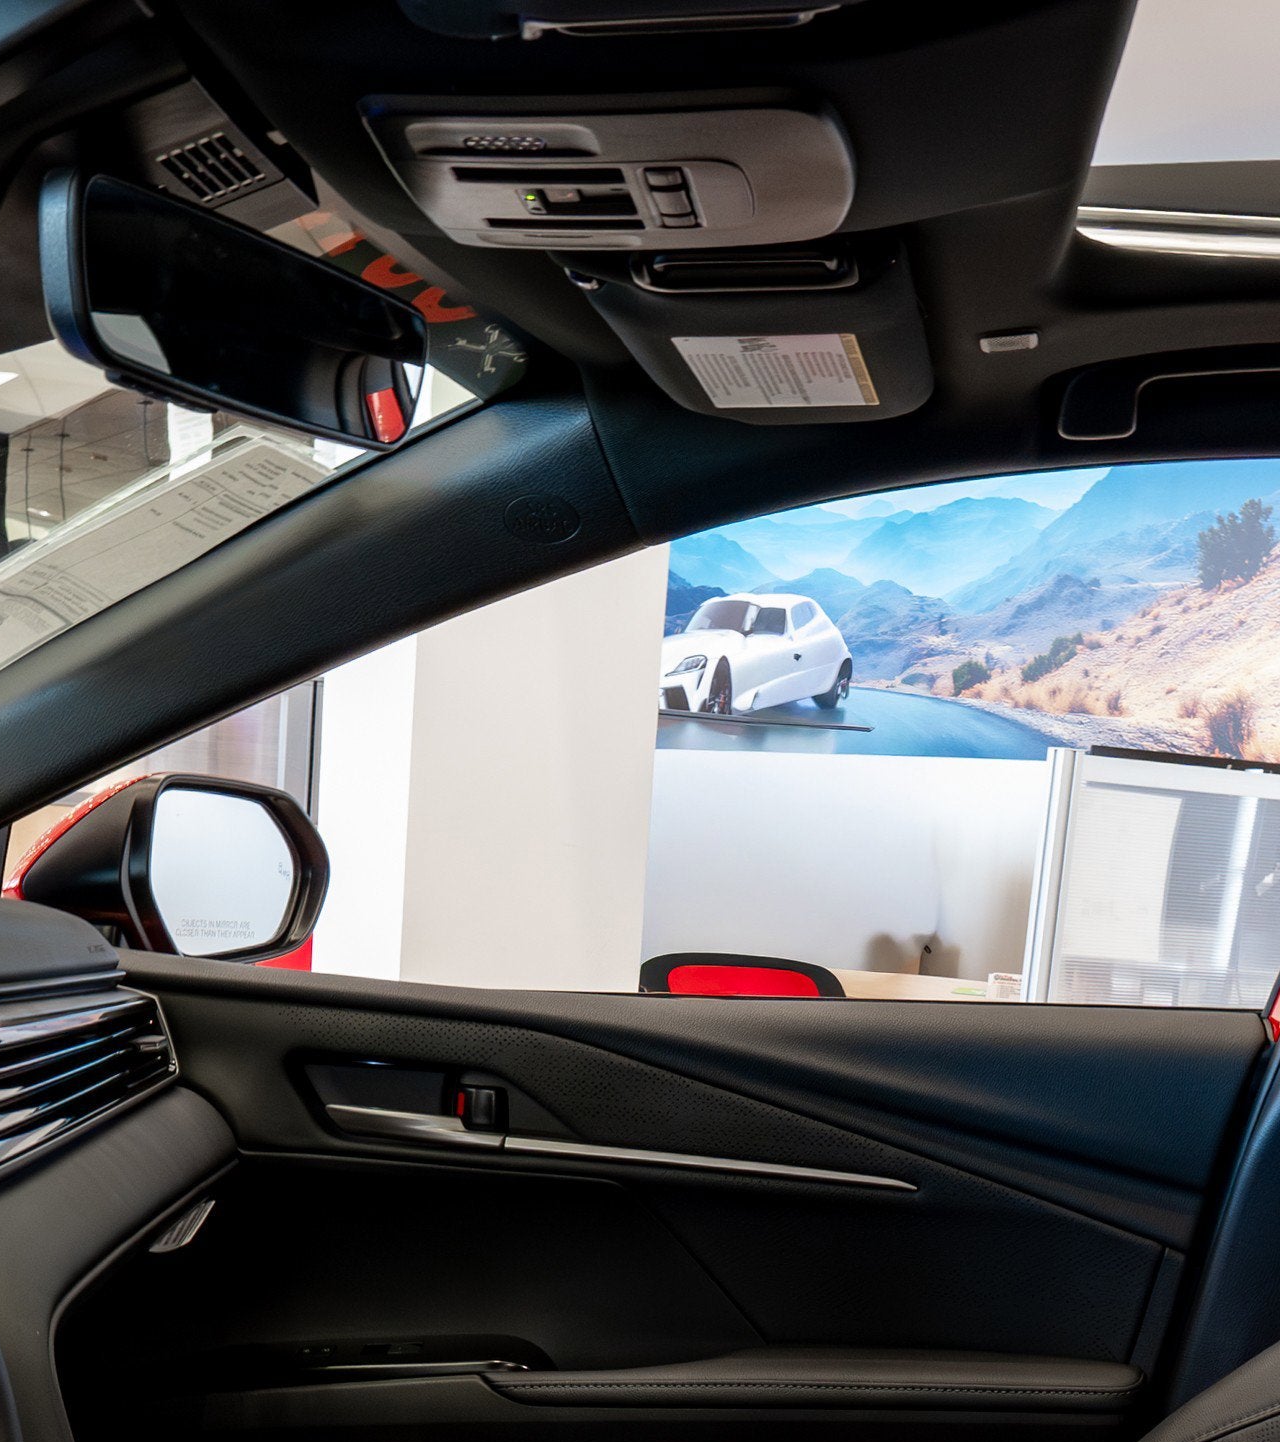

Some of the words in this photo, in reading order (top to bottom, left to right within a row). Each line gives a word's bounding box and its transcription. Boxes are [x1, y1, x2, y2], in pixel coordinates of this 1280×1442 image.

[181, 918, 208, 928] OBJECTS
[215, 920, 238, 929] MIRROR
[239, 920, 250, 930] ARE
[175, 928, 199, 938] CLOSER
[200, 929, 216, 938] THAN
[217, 930, 232, 938] THEY
[232, 930, 255, 939] APPEAR
